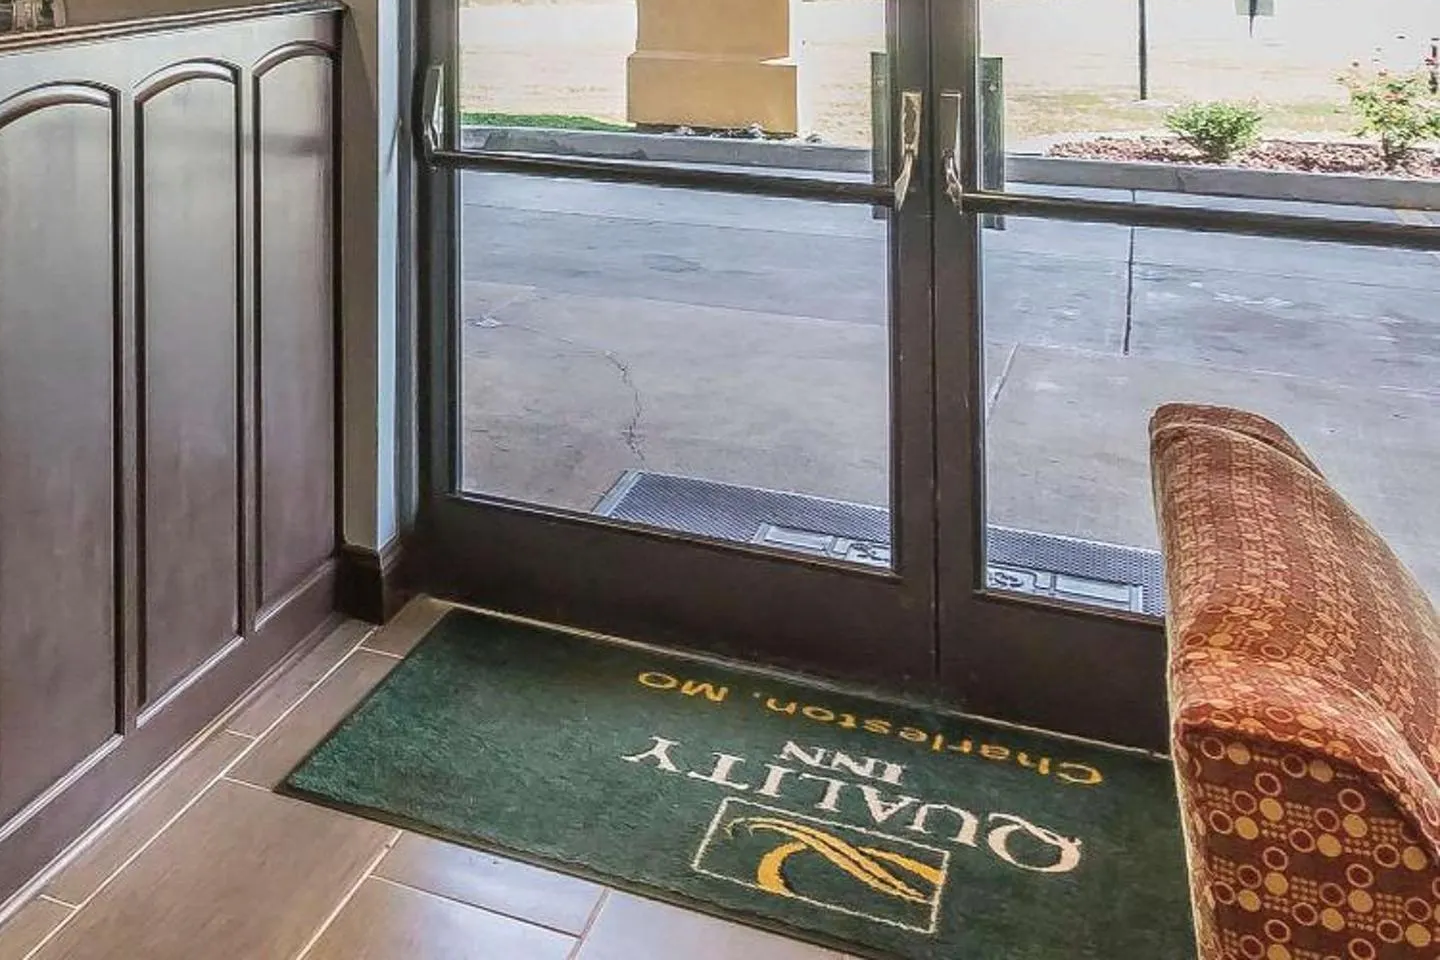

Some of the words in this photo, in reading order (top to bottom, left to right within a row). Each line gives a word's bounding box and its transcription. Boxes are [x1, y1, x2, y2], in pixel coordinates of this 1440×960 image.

[637, 671, 729, 702] MO
[778, 739, 905, 784] INN
[621, 736, 1083, 873] QUALITY
